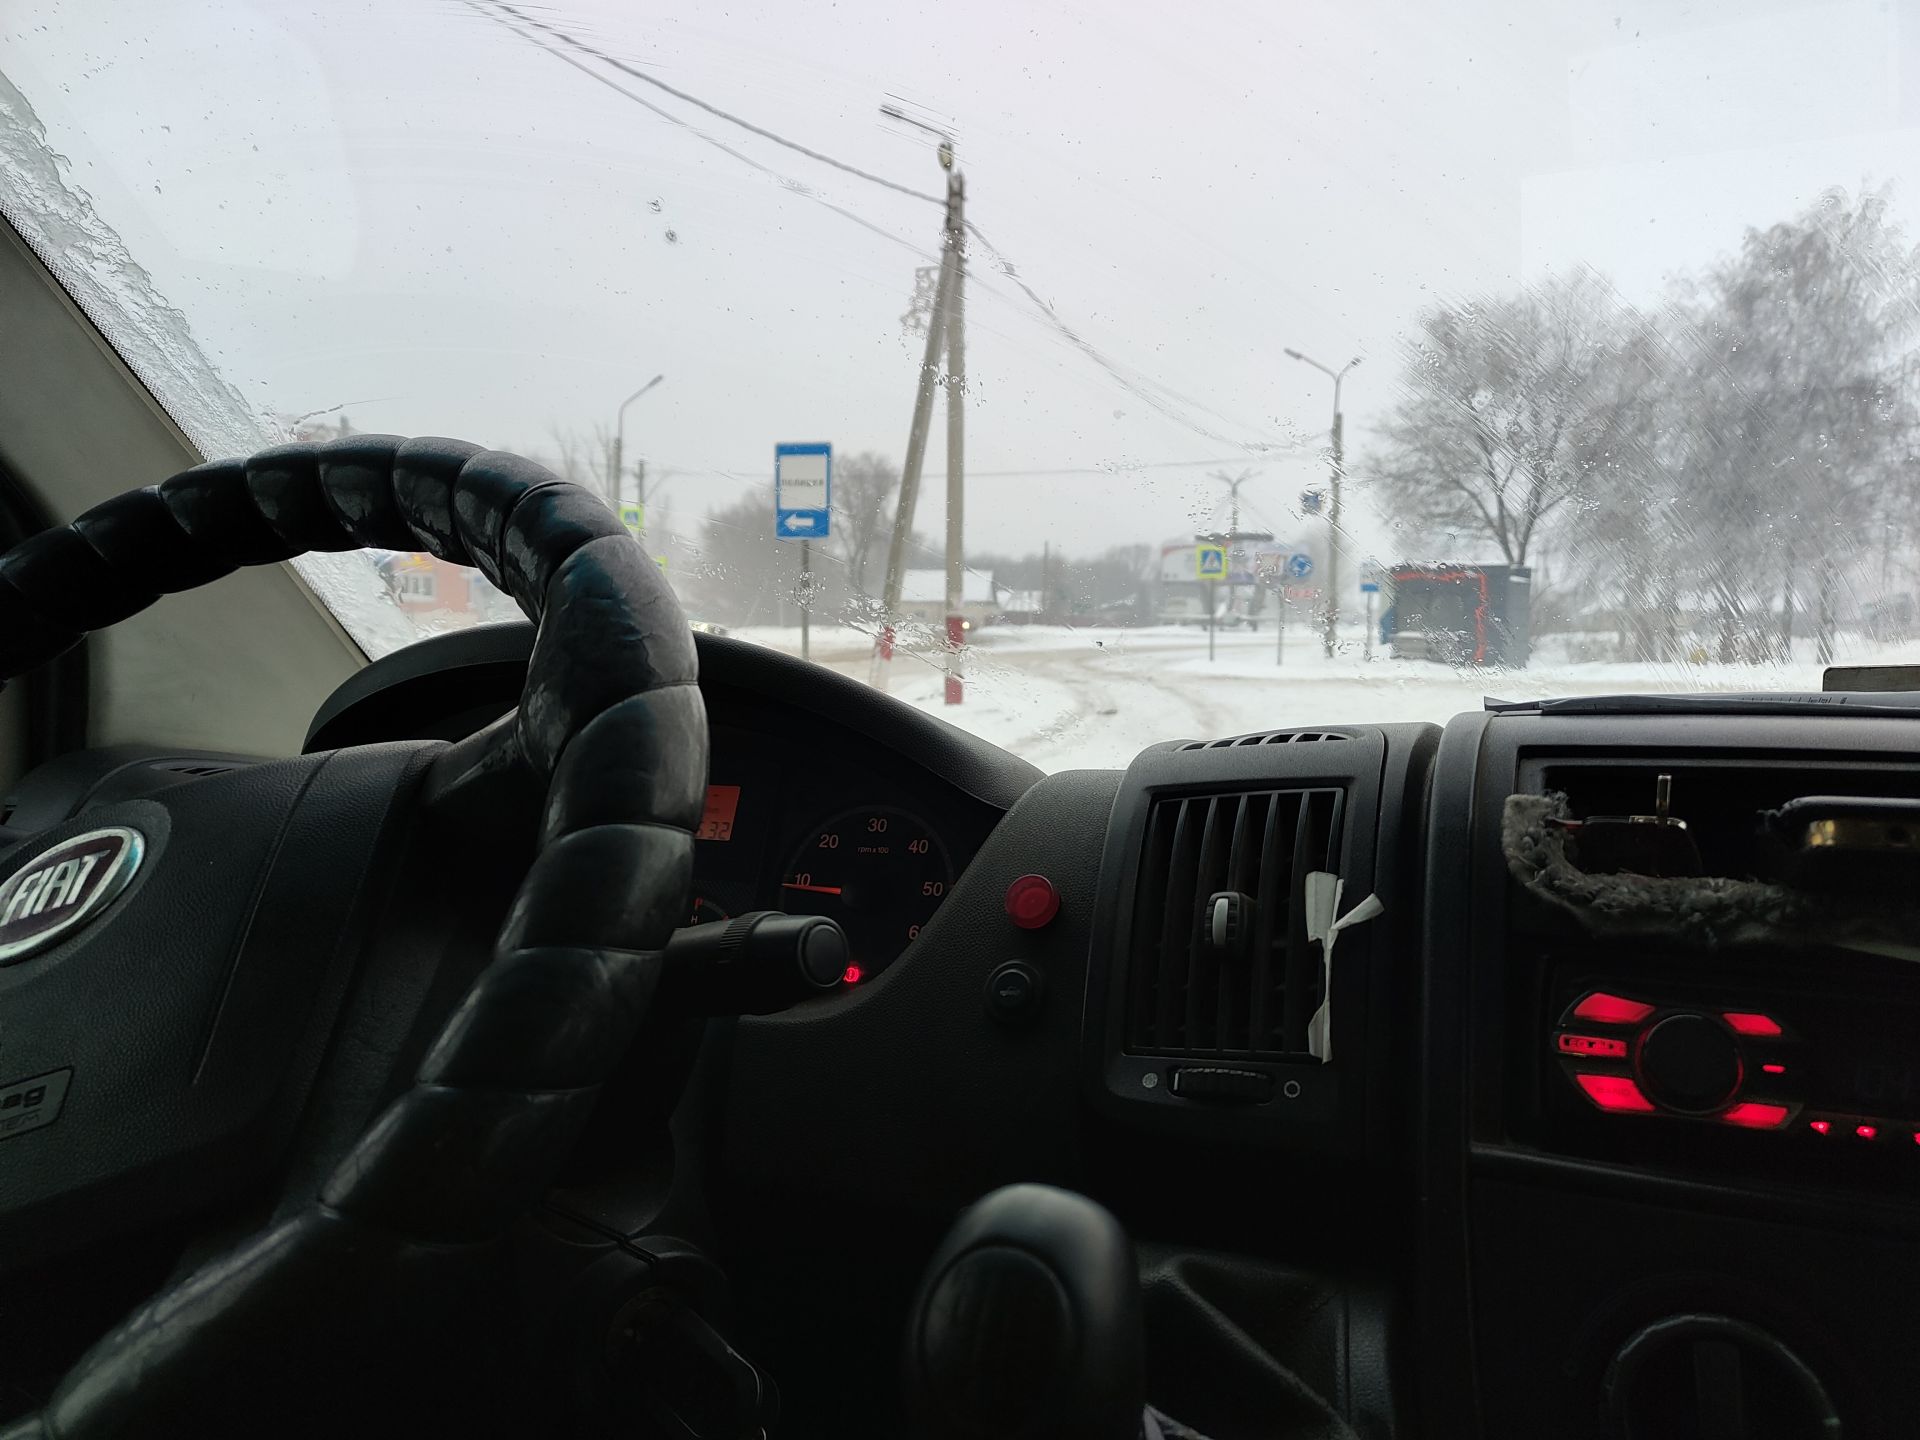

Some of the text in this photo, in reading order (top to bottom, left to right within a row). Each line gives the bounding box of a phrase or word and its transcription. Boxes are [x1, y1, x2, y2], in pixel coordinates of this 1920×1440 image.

[866, 817, 888, 833] 30
[818, 833, 839, 849] 20
[907, 839, 929, 854] 40
[794, 872, 812, 886] 10
[0, 849, 112, 927] FIAT
[921, 880, 944, 897] 50
[908, 924, 920, 940] 6
